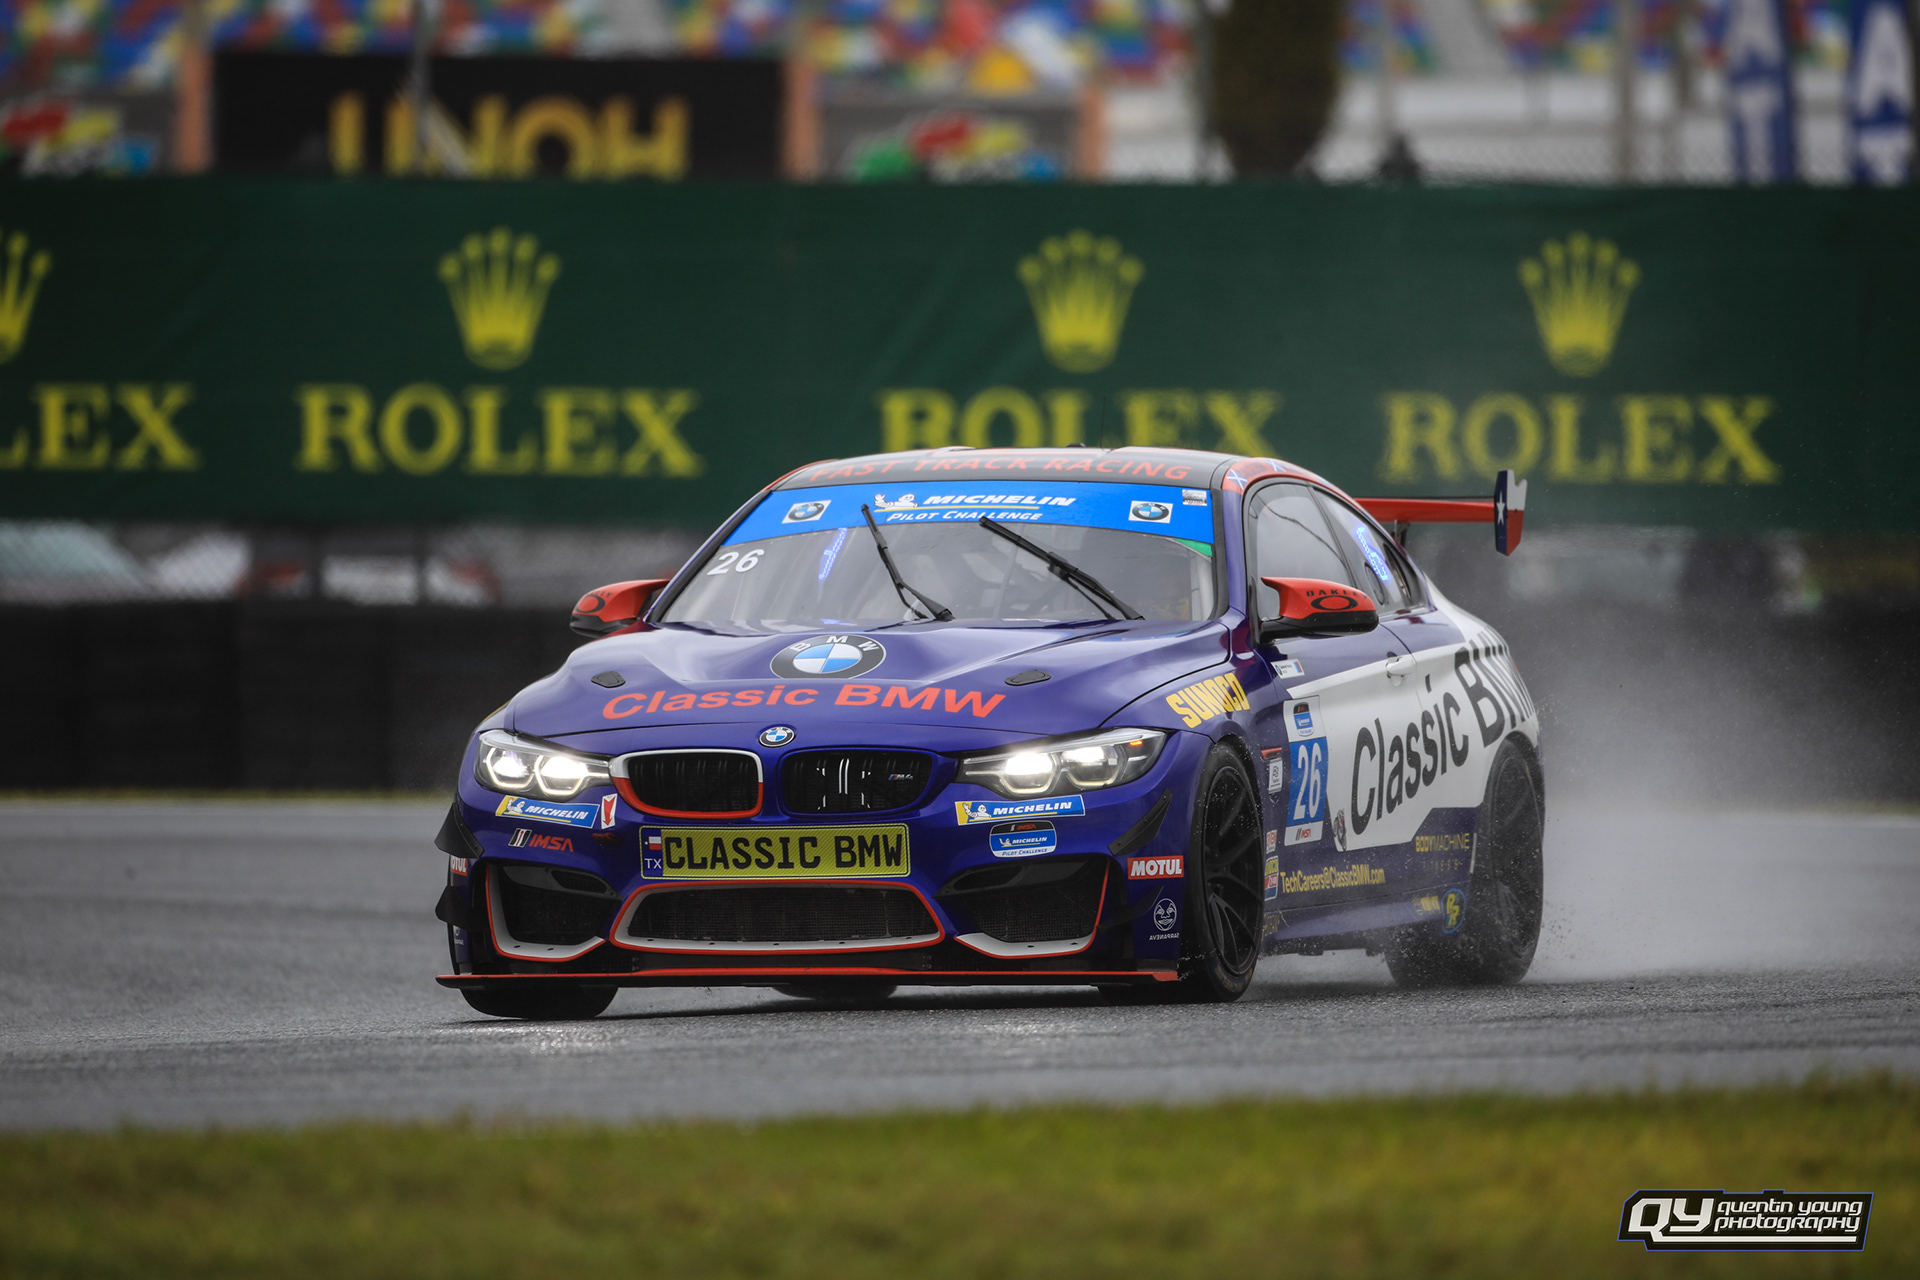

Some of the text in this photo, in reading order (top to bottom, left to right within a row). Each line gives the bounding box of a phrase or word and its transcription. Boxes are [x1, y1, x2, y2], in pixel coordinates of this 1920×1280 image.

[295, 383, 704, 478] ROLEX
[1378, 390, 1779, 484] ROLEX
[809, 457, 1192, 482] FAST TRACK RACING
[923, 494, 1076, 507] MICHELIN
[886, 511, 1043, 522] PILOT CHALLENGE
[706, 549, 765, 576] 26
[602, 684, 1006, 719] Classic BMW
[1165, 672, 1250, 728] SUNOCO
[1351, 674, 1469, 836] Classic
[1293, 742, 1322, 820] 26
[525, 805, 588, 820] MICHELIN
[993, 802, 1072, 815] MICHELIN
[528, 834, 574, 852] IMSA
[664, 834, 903, 869] CLASSIC BMW
[644, 858, 662, 869] TX
[1130, 859, 1182, 877] MOTUL
[1280, 863, 1386, 893] TechCareers@ClassicBMW.com
